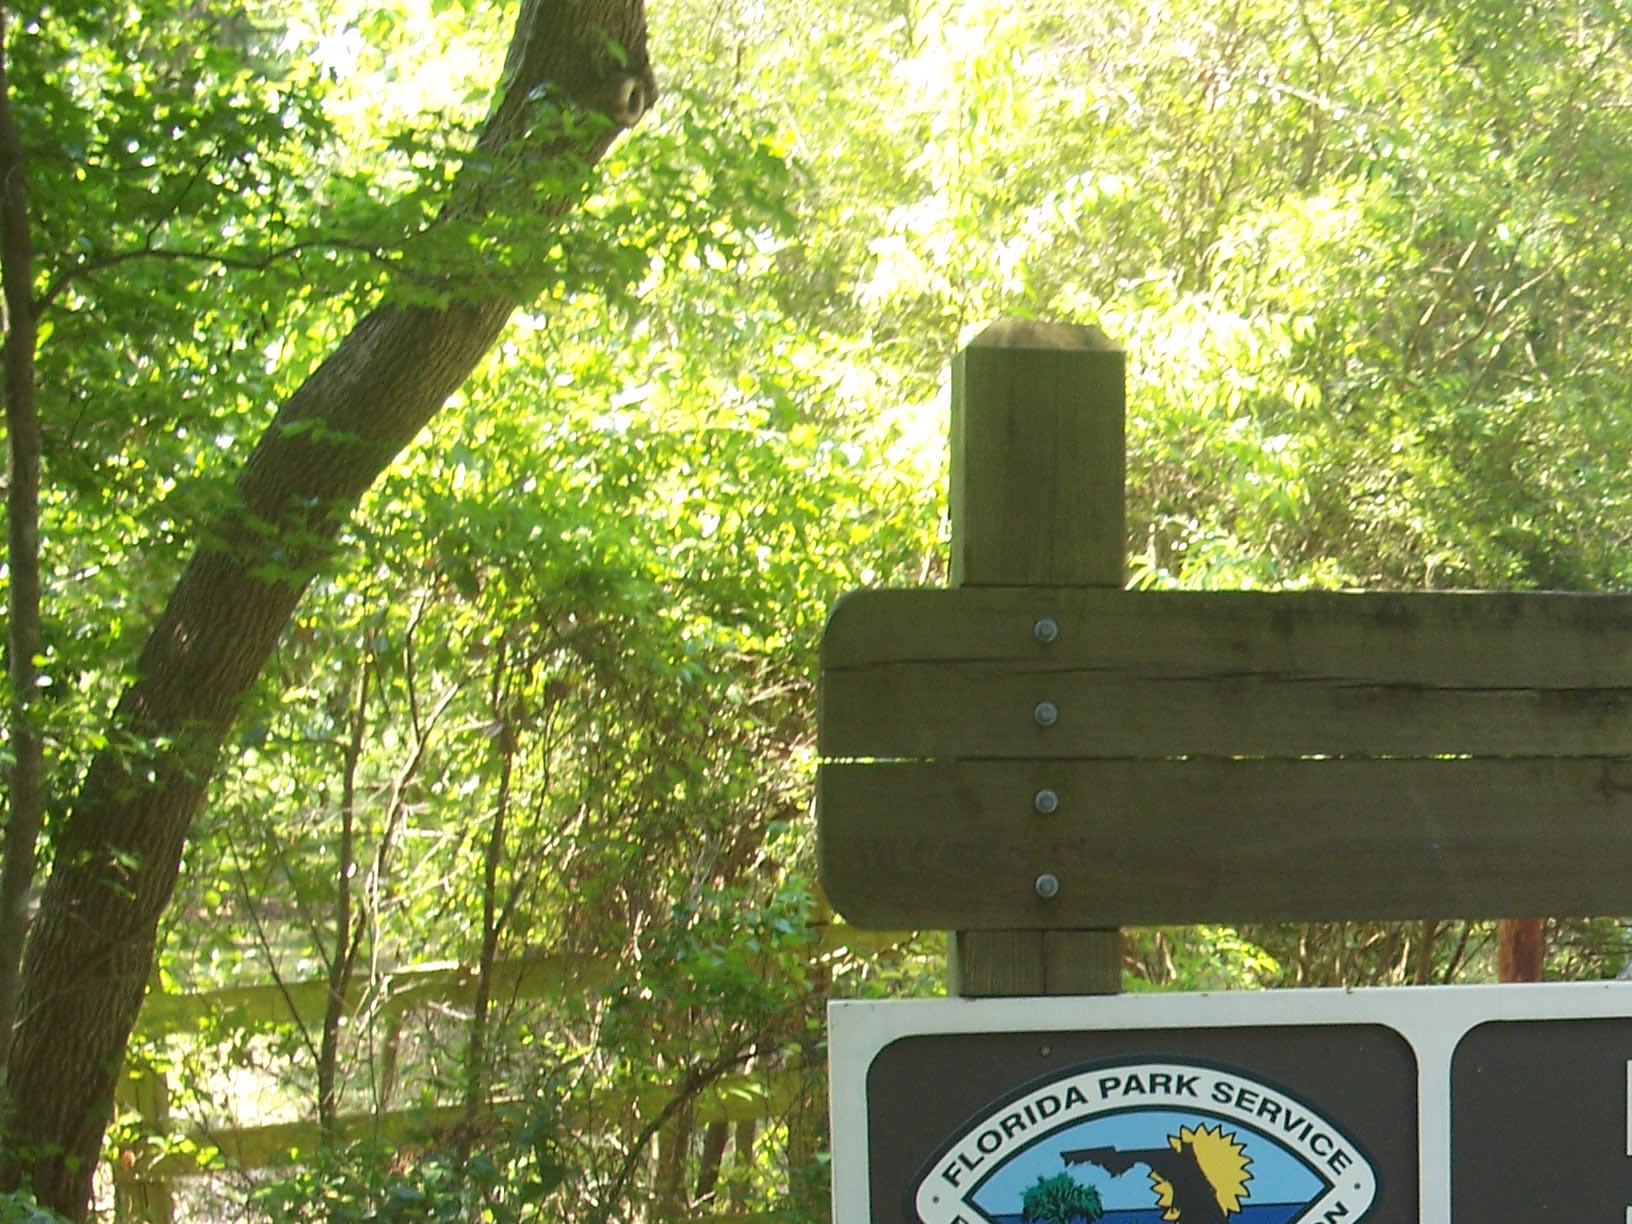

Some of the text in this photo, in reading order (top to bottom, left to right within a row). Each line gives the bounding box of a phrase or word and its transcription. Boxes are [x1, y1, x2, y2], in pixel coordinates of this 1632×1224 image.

[941, 1073, 1354, 1189] FLORIDA PARK SERVICE
